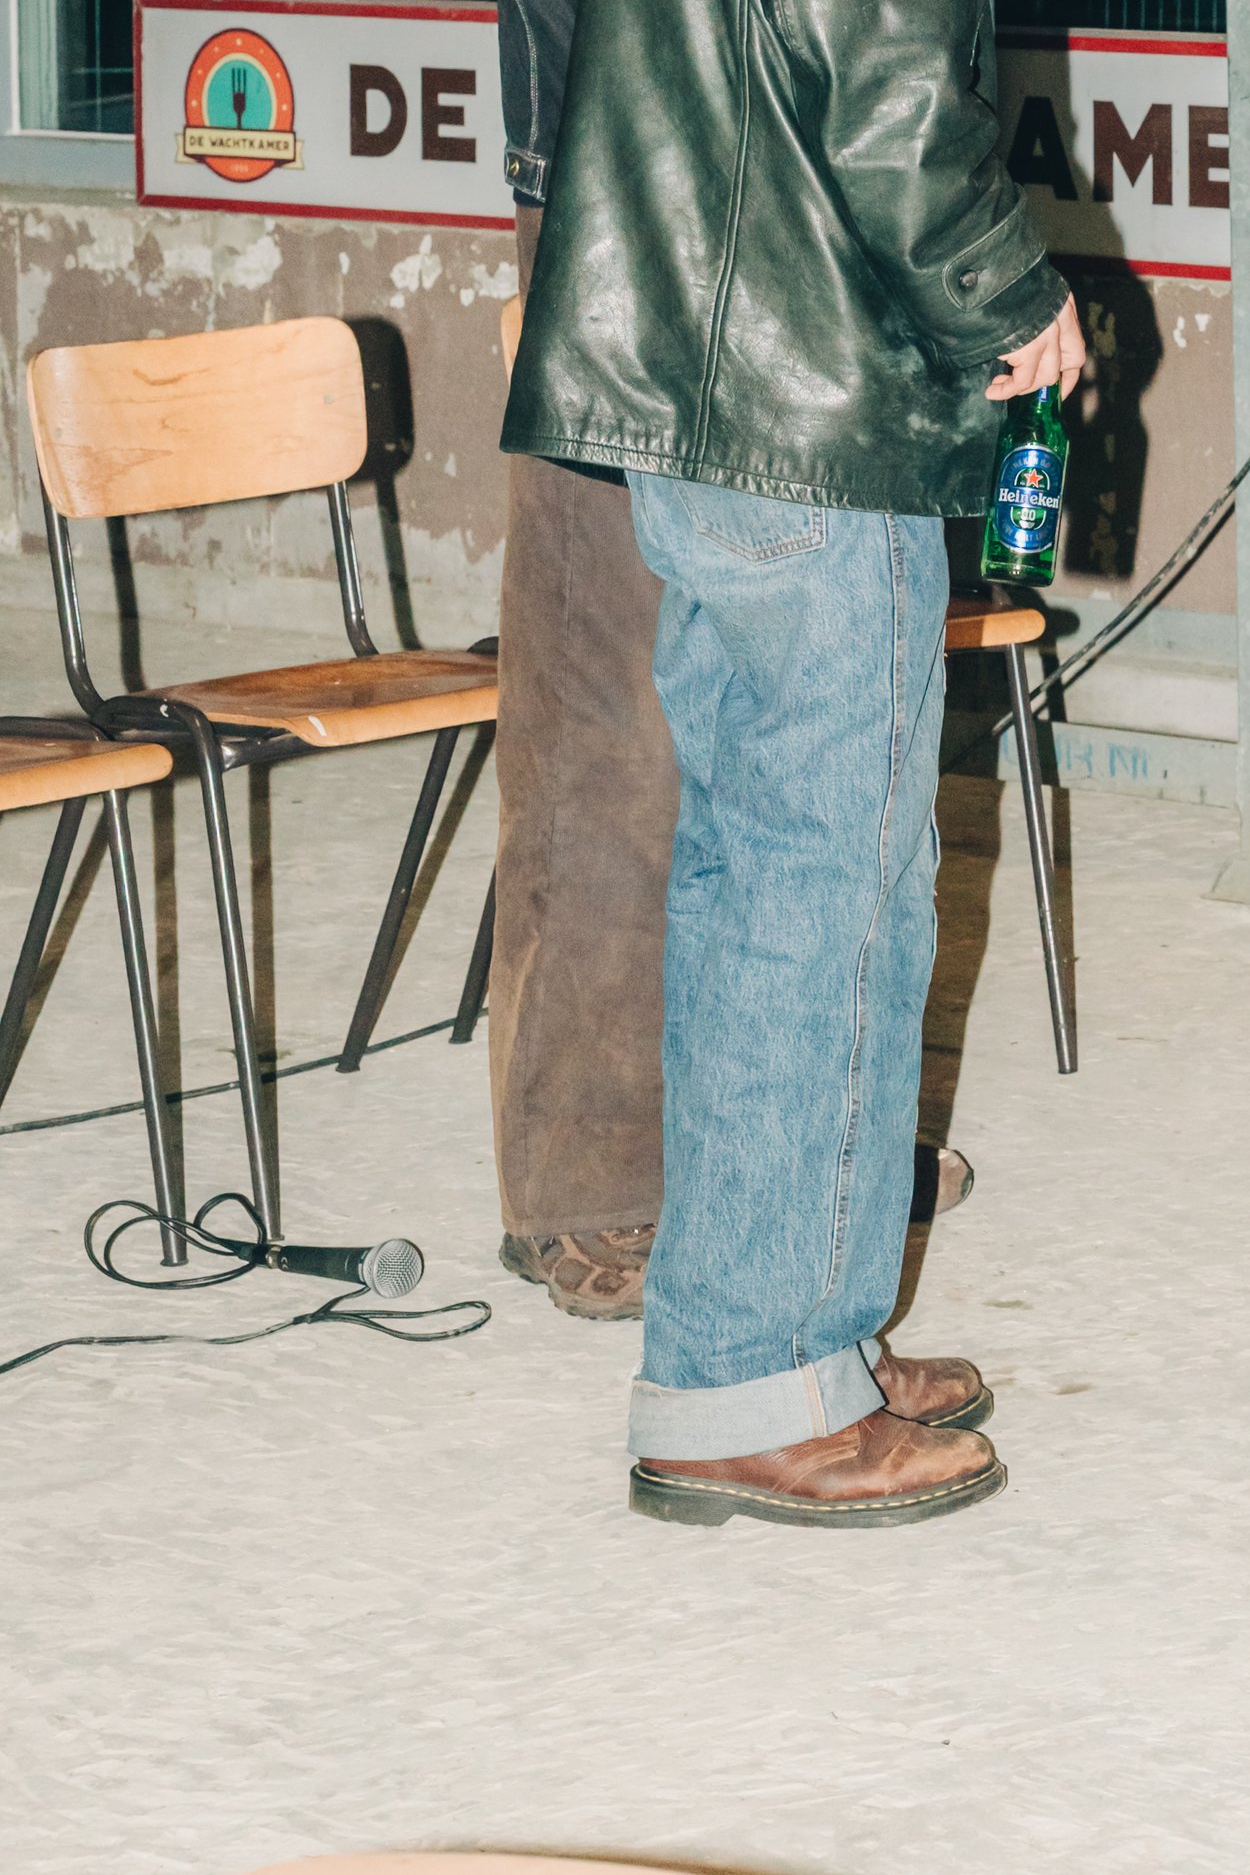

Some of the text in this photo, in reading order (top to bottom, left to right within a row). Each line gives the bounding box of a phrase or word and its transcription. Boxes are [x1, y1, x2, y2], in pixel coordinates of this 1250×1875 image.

[349, 63, 477, 163] DE
[189, 135, 290, 151] DE WACHTKAMER
[998, 488, 1059, 508] Heineken
